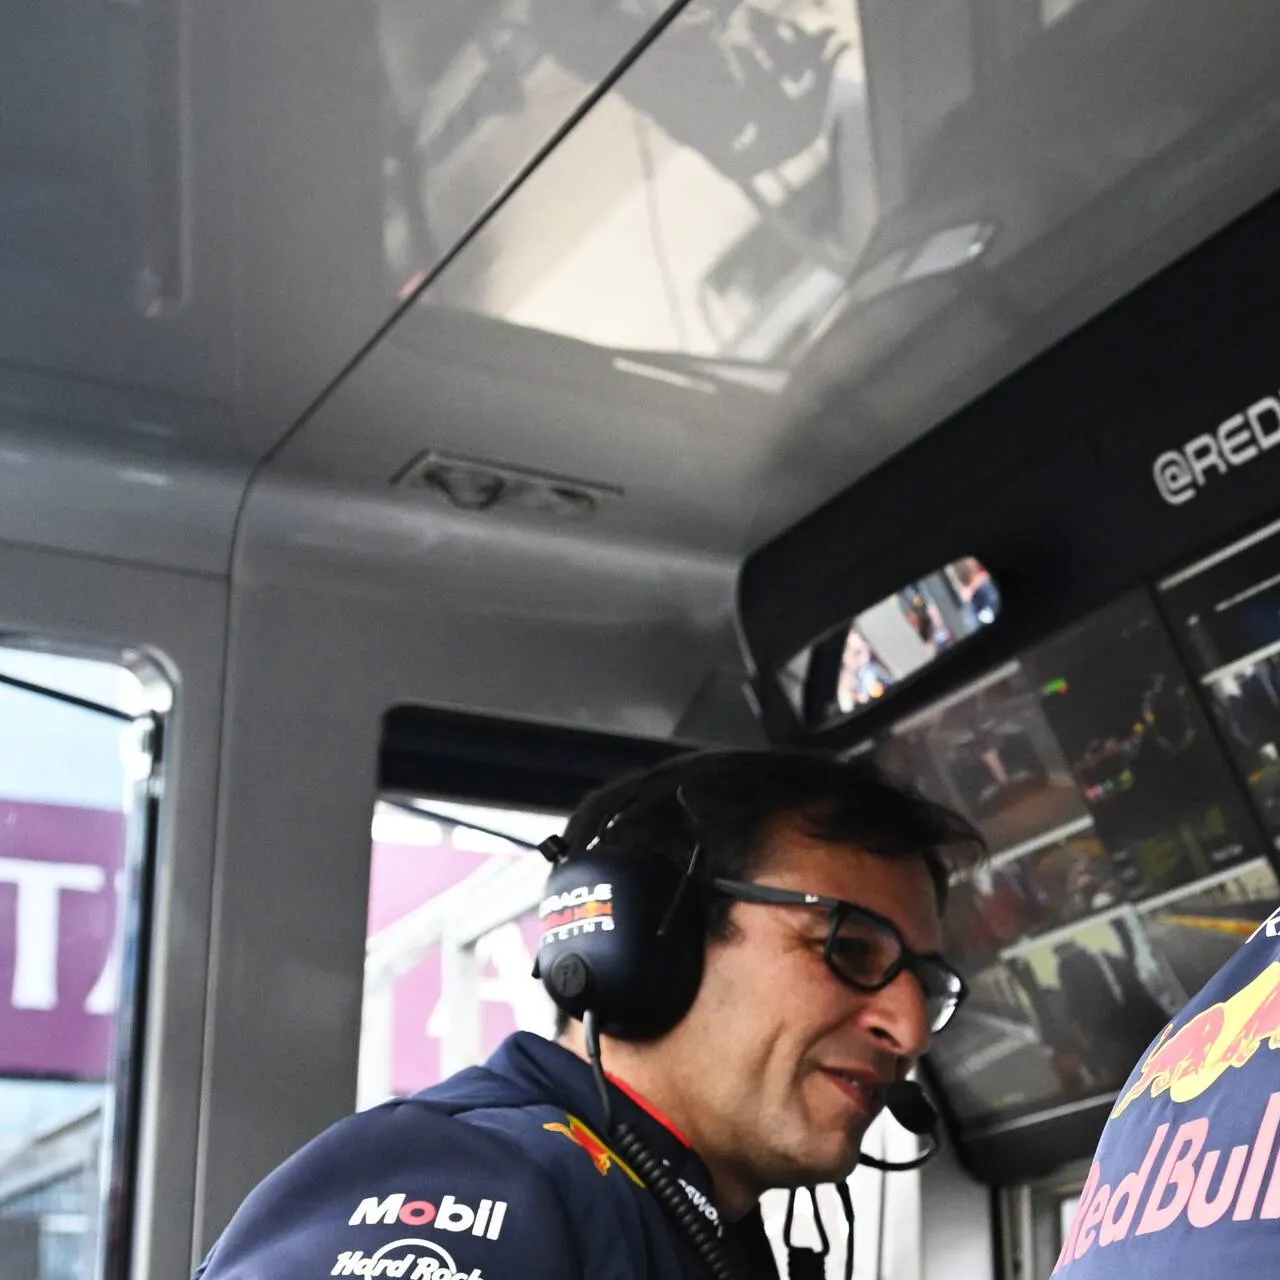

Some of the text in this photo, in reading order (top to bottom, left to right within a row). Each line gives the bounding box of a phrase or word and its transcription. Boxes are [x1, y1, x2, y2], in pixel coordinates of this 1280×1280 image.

[349, 1193, 508, 1241] Mobil
[1052, 1123, 1170, 1277] Red
[331, 1251, 415, 1278] Hard
